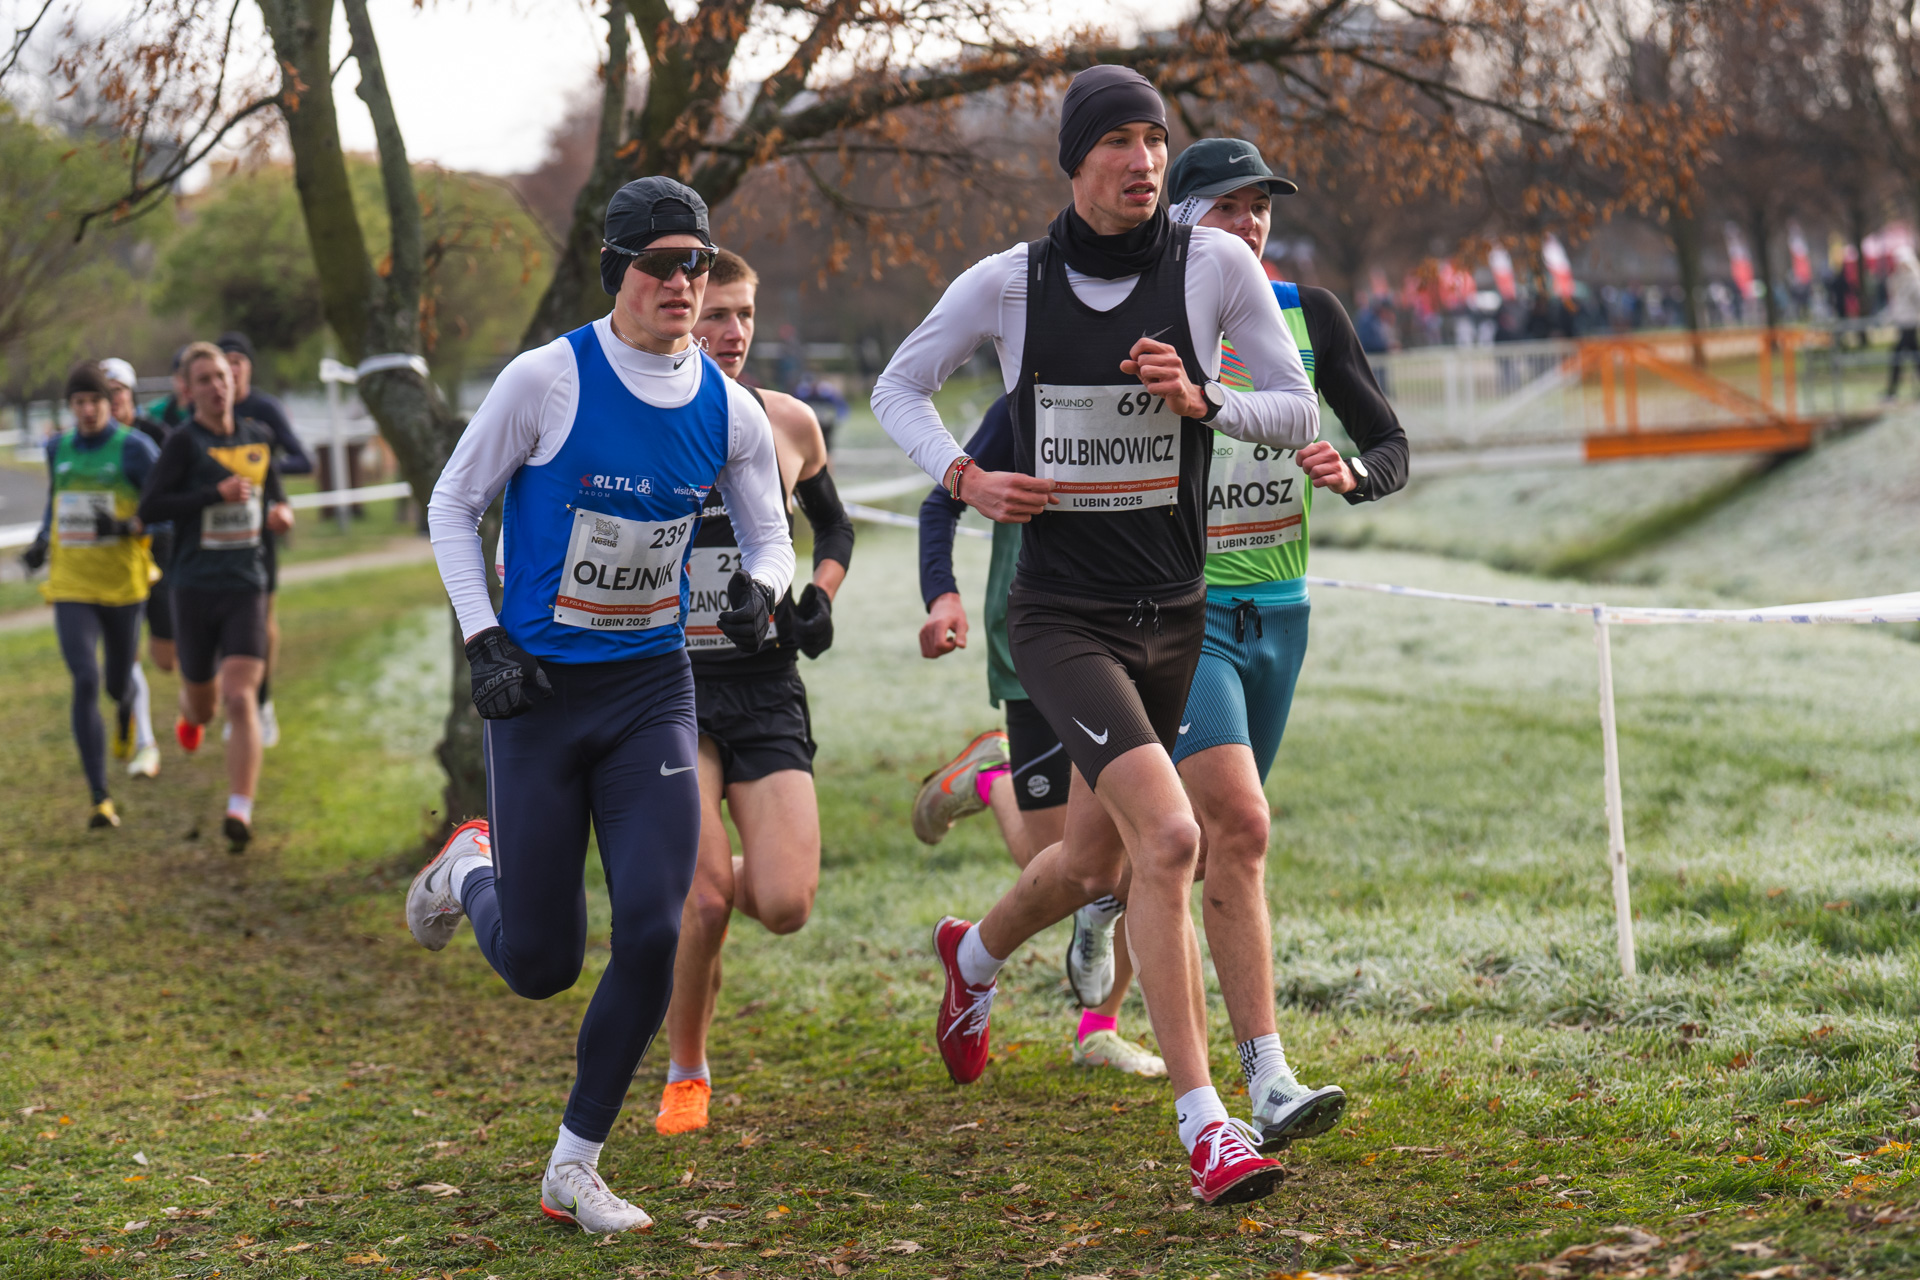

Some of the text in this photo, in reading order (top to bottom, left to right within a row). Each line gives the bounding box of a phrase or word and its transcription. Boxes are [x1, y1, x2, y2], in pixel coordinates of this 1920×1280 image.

[1054, 398, 1094, 408] MUNDO
[1117, 391, 1166, 417] 697
[1040, 434, 1174, 466] GULBINOWICZ
[592, 474, 634, 492] RLTL
[1119, 483, 1142, 491] Biegach
[578, 489, 611, 498] RADOM
[1072, 495, 1143, 508] LUBIN 2025
[649, 522, 687, 550] 239
[1217, 534, 1276, 550] LUBIN 2025
[573, 559, 677, 592] OLEJNIK
[569, 599, 582, 608] PZLA
[590, 616, 651, 627] LUBIN 2025
[691, 637, 718, 647] UBIN
[472, 666, 524, 704] BRUBECK
